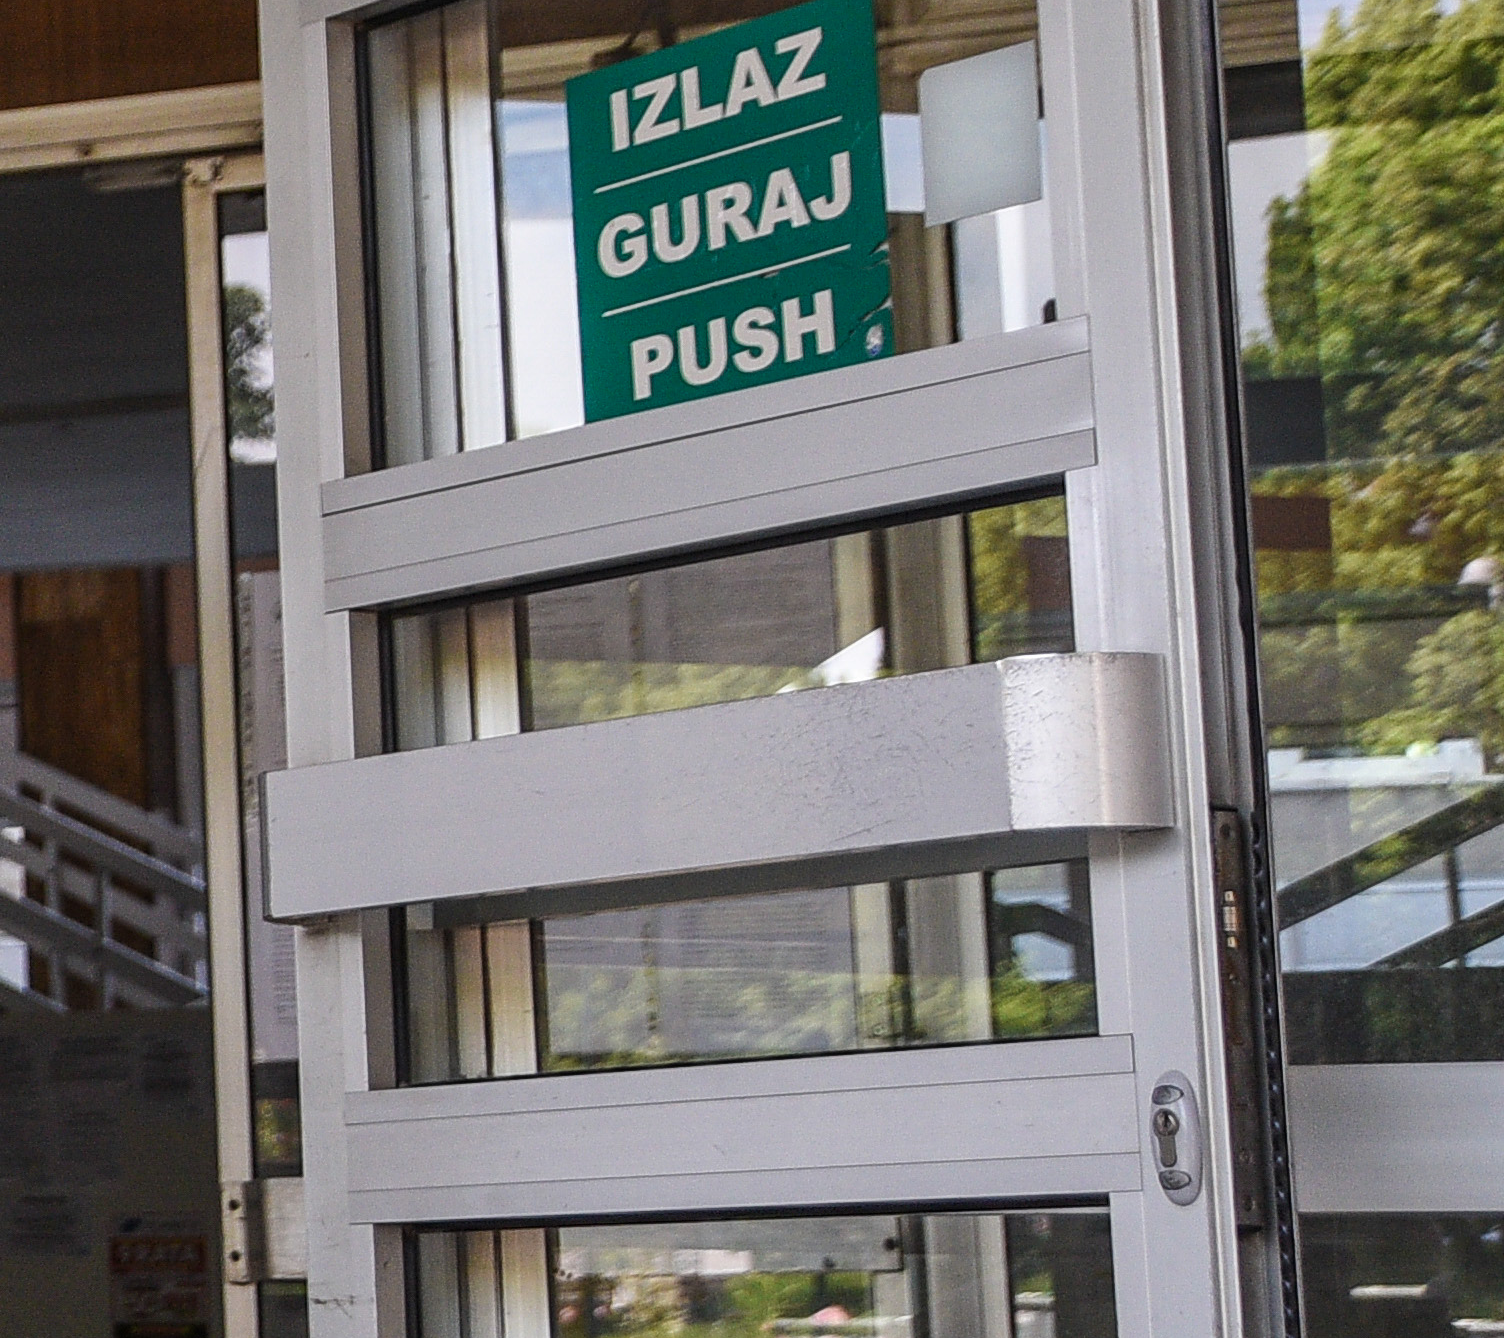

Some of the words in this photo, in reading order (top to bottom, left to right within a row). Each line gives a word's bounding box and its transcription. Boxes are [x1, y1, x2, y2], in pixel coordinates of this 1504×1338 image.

[609, 26, 826, 152] IZLAZ
[597, 150, 852, 278] GURAJ
[630, 289, 836, 401] PUSH
